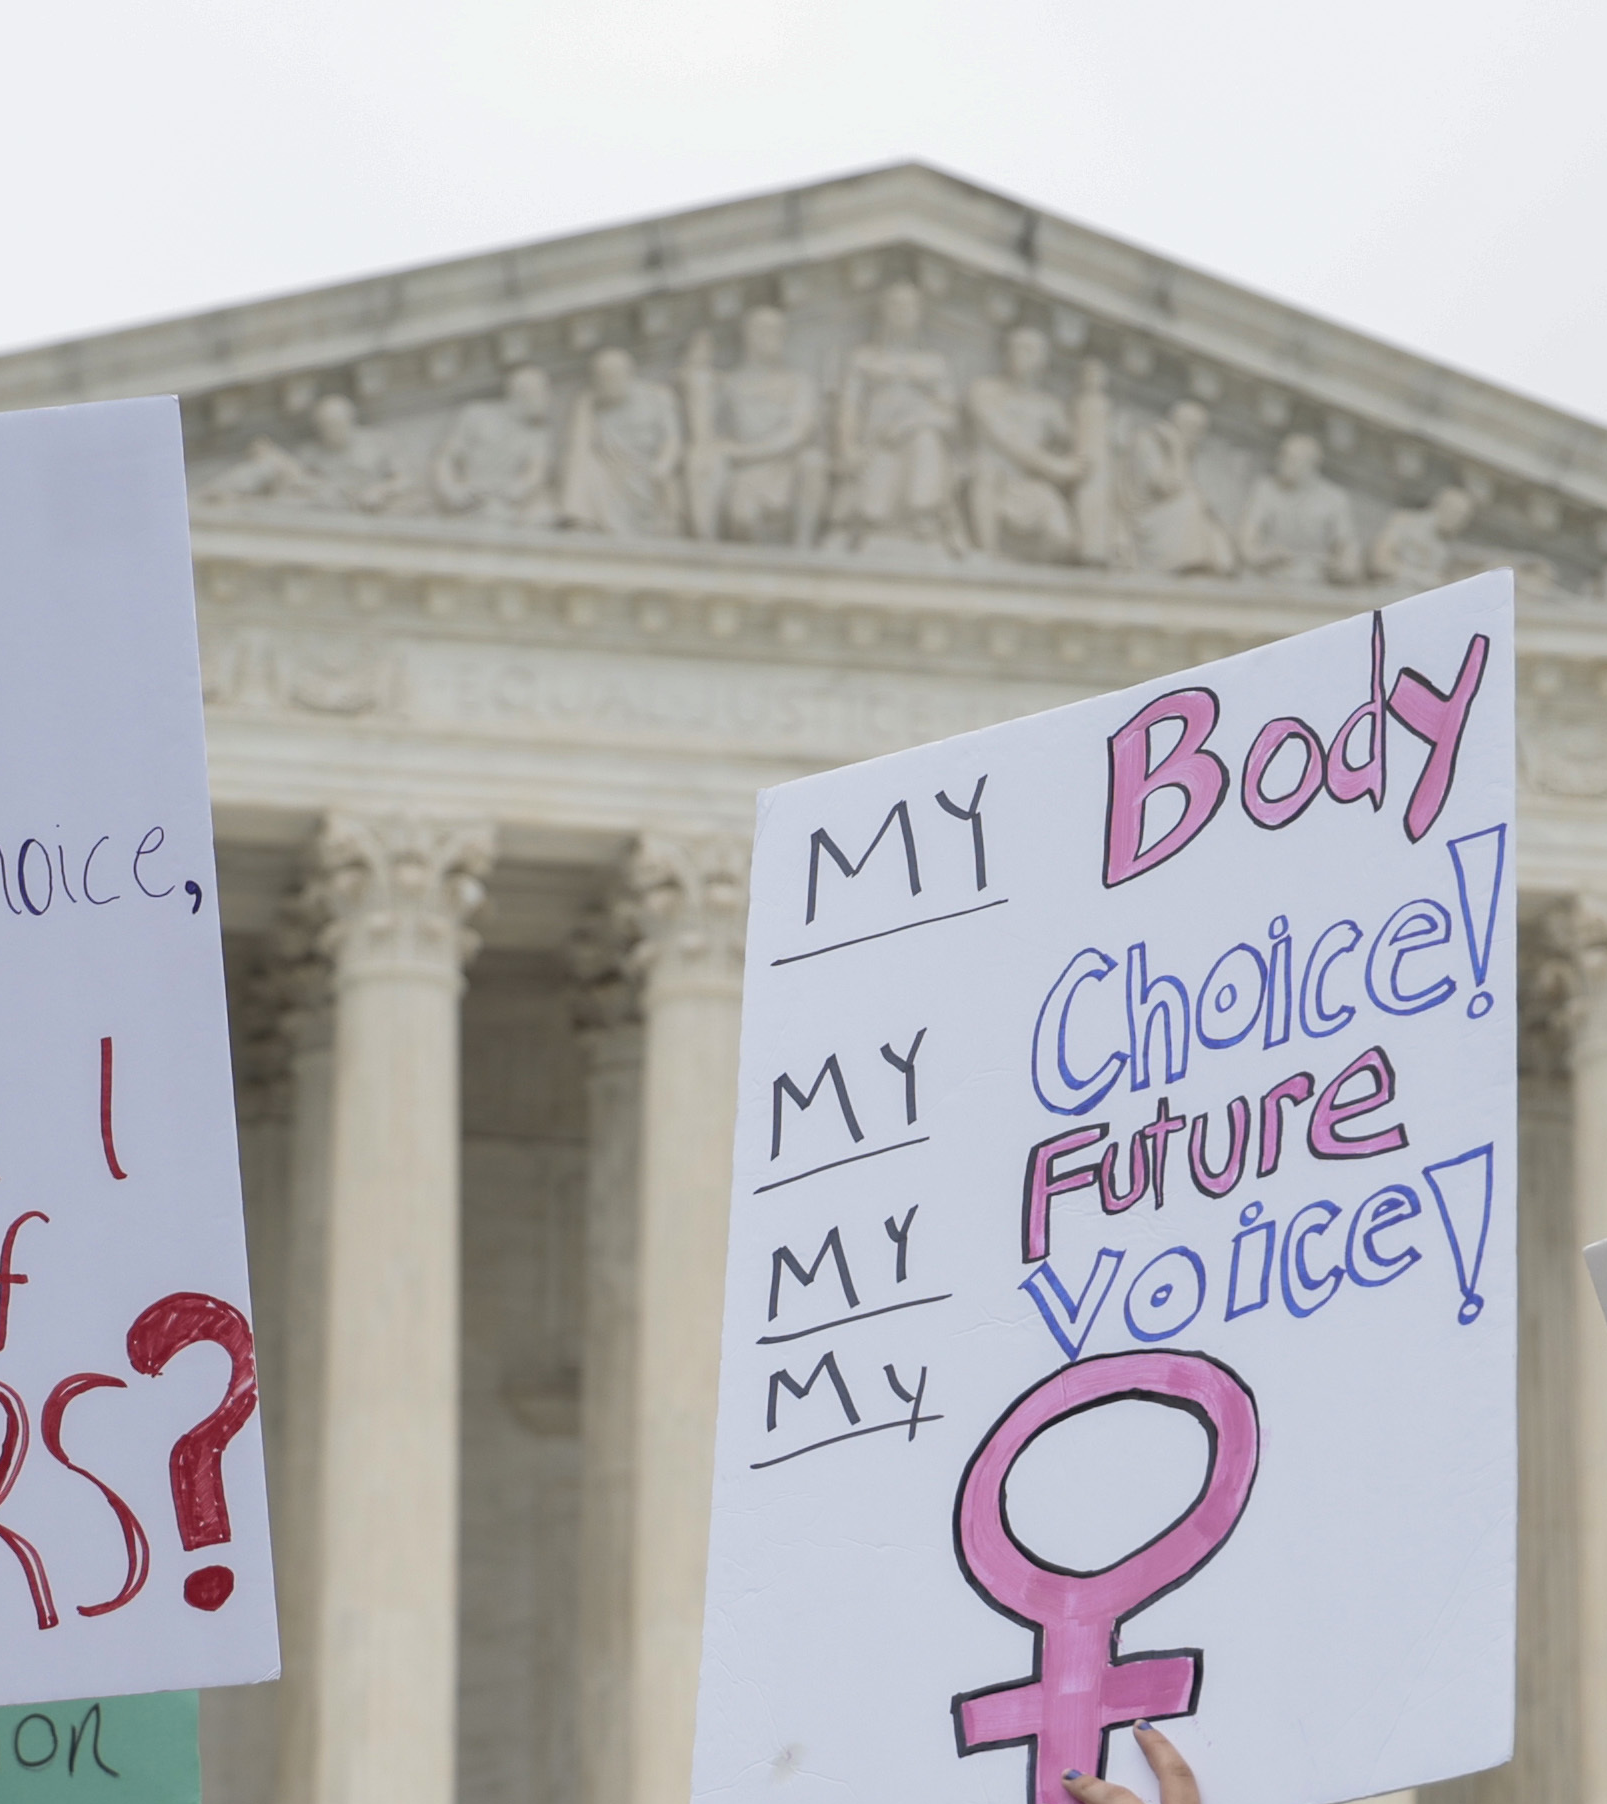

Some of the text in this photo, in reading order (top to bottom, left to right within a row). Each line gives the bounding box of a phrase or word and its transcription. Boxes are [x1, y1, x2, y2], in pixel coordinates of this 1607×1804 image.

[806, 774, 989, 926] MY
[769, 823, 1508, 1162] MY Choice!
[99, 1036, 129, 1181] I
[767, 1203, 920, 1322] MY
